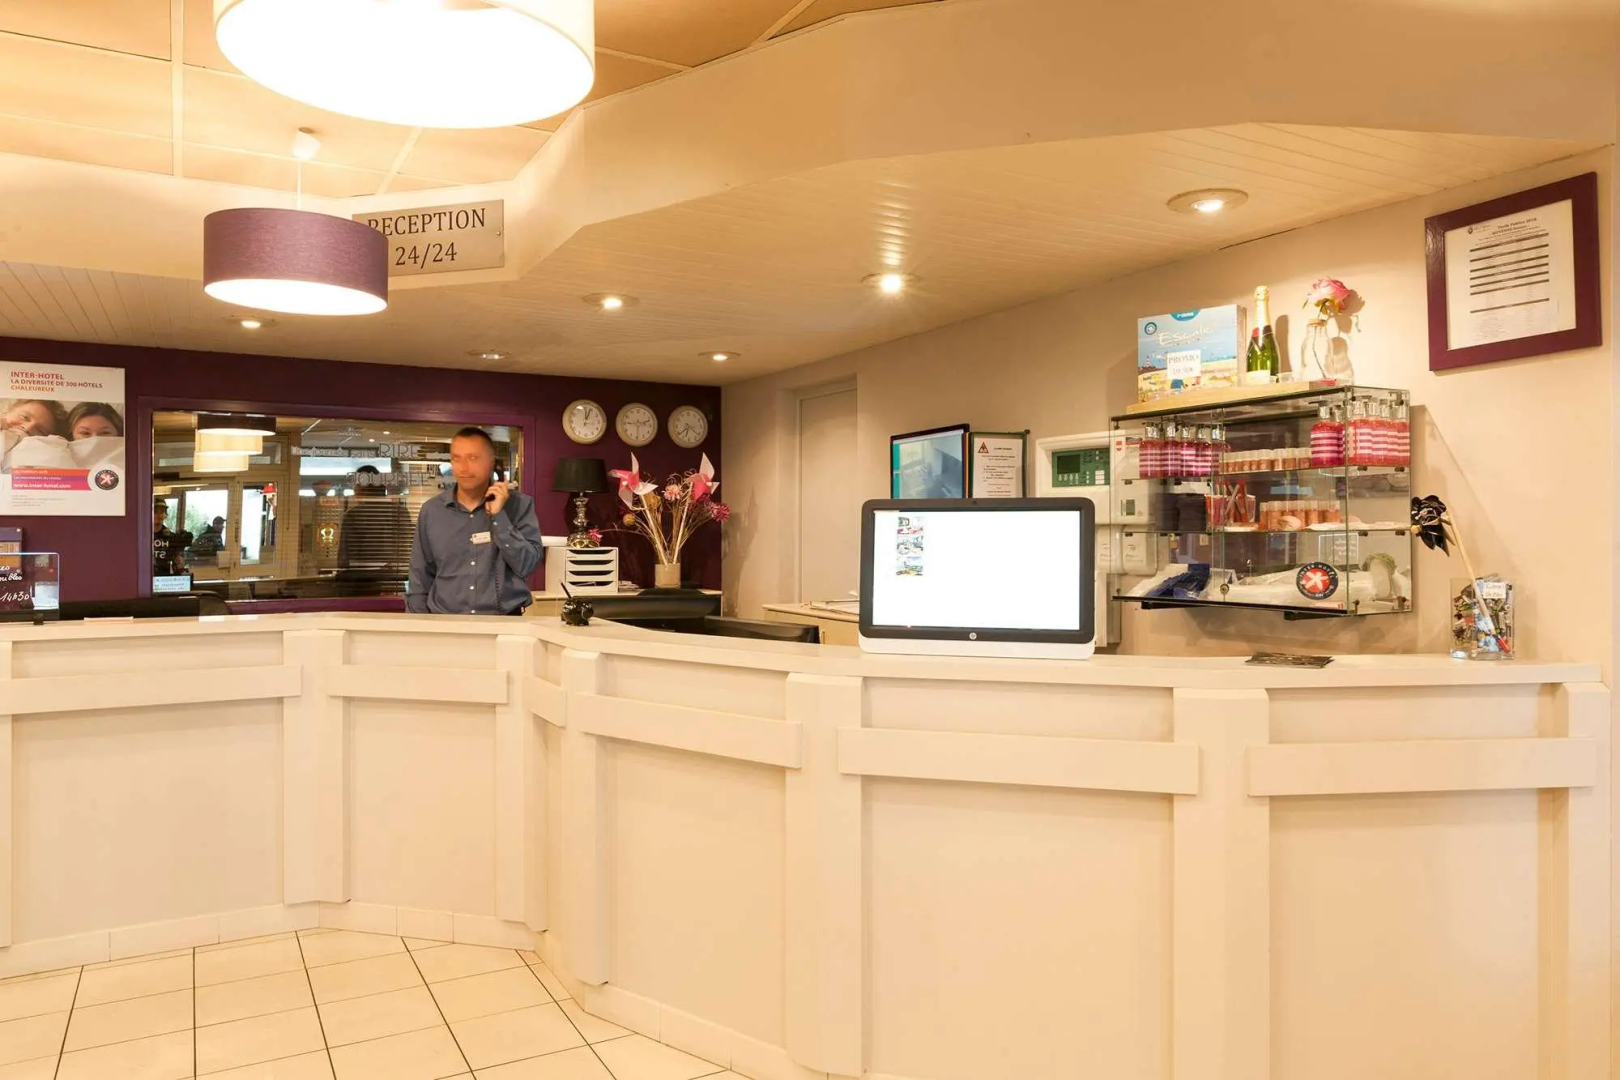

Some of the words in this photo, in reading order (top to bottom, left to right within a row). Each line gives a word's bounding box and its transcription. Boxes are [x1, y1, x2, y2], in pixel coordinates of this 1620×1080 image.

[367, 208, 485, 237] RECEPTION
[395, 242, 457, 269] 24/24
[11, 371, 64, 380] INTER-HOTEL
[379, 443, 421, 459] RIRE
[0, 591, 30, 602] 14h30
